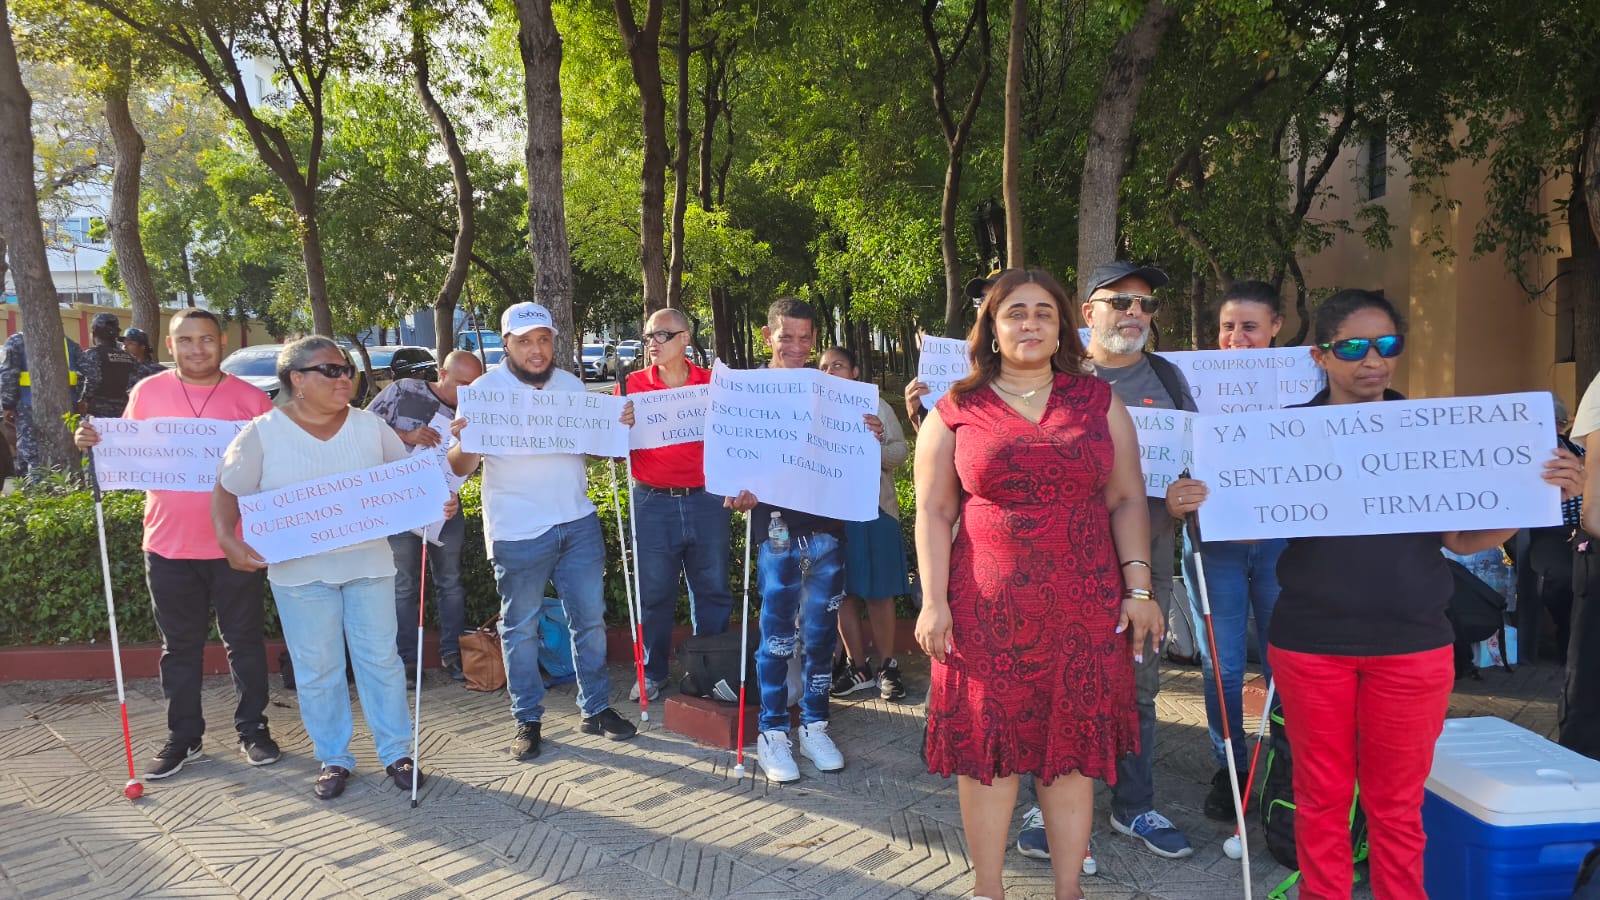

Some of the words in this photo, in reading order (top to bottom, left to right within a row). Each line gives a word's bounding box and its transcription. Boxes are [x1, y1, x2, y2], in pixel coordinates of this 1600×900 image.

[922, 341, 951, 355] LUIS
[920, 363, 948, 376] LOS
[1192, 356, 1296, 371] COMPROMISO
[714, 375, 743, 392] LUIS
[747, 382, 807, 395] MIGUEL
[812, 382, 827, 398] DE
[1217, 381, 1260, 396] HAY
[568, 395, 577, 407] Y
[584, 396, 600, 409] EL
[640, 391, 697, 405] ACEPTAMOS
[647, 413, 667, 425] SIN
[711, 401, 781, 421] ESCUCHA
[792, 409, 812, 421] LA
[155, 422, 217, 436] CIEGOS
[527, 414, 554, 427] POR
[557, 416, 611, 431] CECAPCI
[1135, 411, 1175, 431] MÁS
[1214, 424, 1247, 444] YA
[1268, 418, 1306, 441] NO
[1326, 410, 1385, 438] MÁS
[481, 434, 576, 449] LUCHAREMOS
[712, 424, 798, 442] QUEREMOS
[726, 447, 760, 461] CON
[782, 453, 843, 479] LEGALIDAD
[1219, 462, 1343, 489] SENTADO
[1361, 445, 1532, 476] QUEREMOS
[97, 471, 186, 485] DERECHOS
[273, 474, 364, 508] QUEREMOS
[250, 503, 344, 535] QUEREMOS
[361, 486, 427, 511] PRONTA
[1254, 503, 1329, 525] TODO
